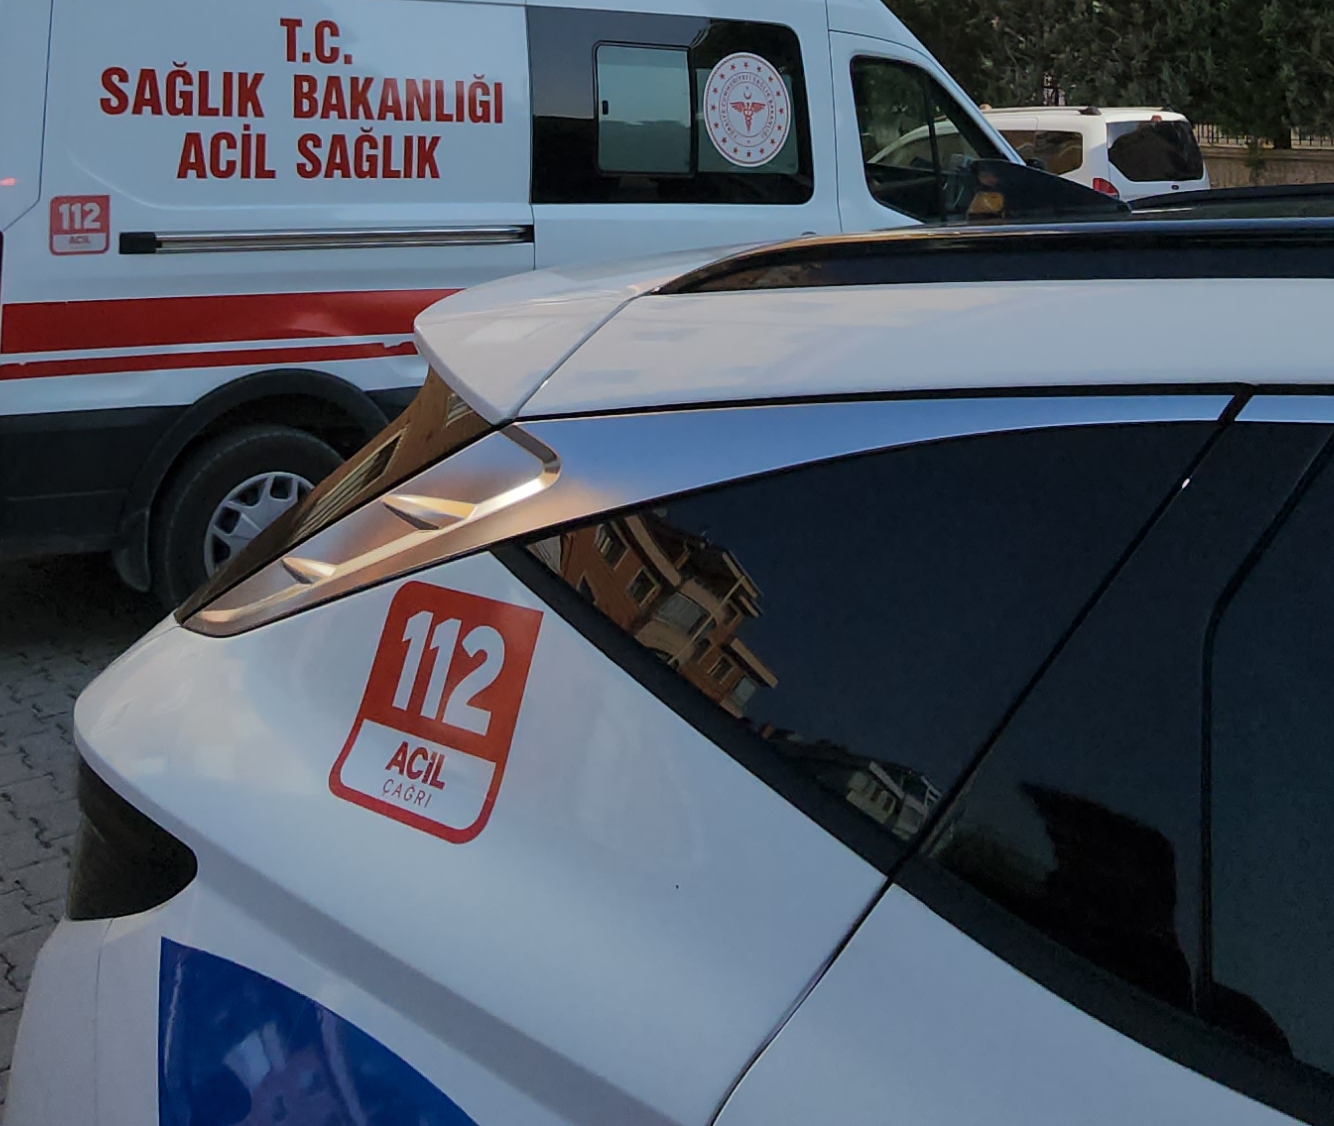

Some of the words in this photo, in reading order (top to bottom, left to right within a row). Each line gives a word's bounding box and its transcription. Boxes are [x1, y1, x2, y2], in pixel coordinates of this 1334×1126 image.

[279, 17, 353, 64] T.C.
[99, 61, 265, 118] SAĞLIK
[292, 74, 504, 124] BAKANLIĞI
[176, 123, 277, 179] ACİL
[296, 126, 442, 179] SAĞLIK
[58, 202, 101, 230] 112
[391, 610, 505, 737] 112
